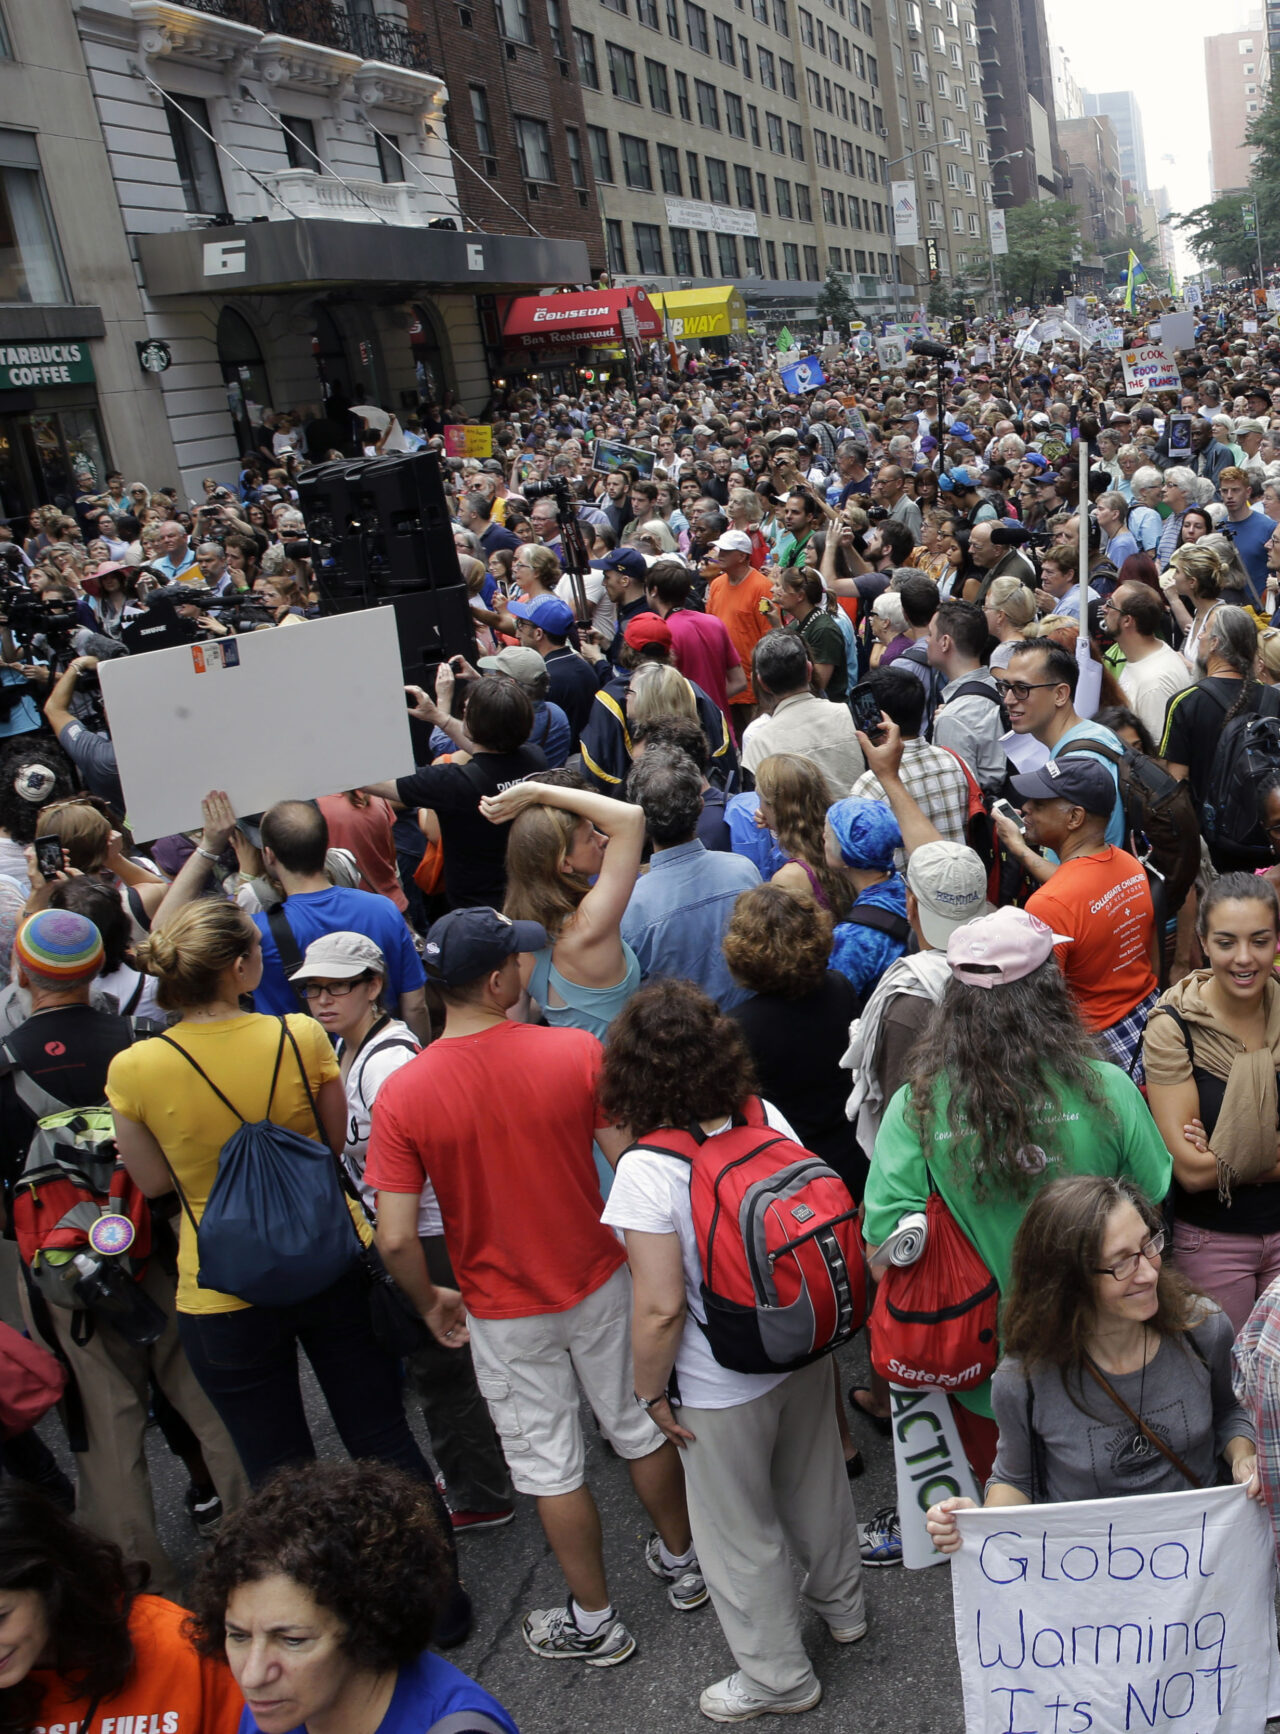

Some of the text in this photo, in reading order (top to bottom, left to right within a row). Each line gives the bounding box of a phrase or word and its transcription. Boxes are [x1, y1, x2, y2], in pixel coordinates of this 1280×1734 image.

[927, 239, 938, 270] PARK
[533, 307, 609, 322] COLISEUM
[667, 313, 725, 336] BWAY
[521, 327, 616, 345] Bar Restaurant
[0, 345, 82, 366] TARBUCKS
[1141, 350, 1168, 361] COOK
[9, 366, 71, 386] COFFEE
[1133, 364, 1174, 377] FOOD NOT
[1127, 376, 1180, 389] THE PLANET
[141, 625, 167, 636] SHURE
[937, 890, 980, 906] BERMUDA
[1091, 884, 1122, 914] COLLEGIATE
[889, 1388, 961, 1514] ACTIO
[979, 1512, 1214, 1584] Global
[976, 1609, 1226, 1677] Warming
[990, 1664, 1238, 1734] Its NOT
[101, 1711, 179, 1734] FUELS
